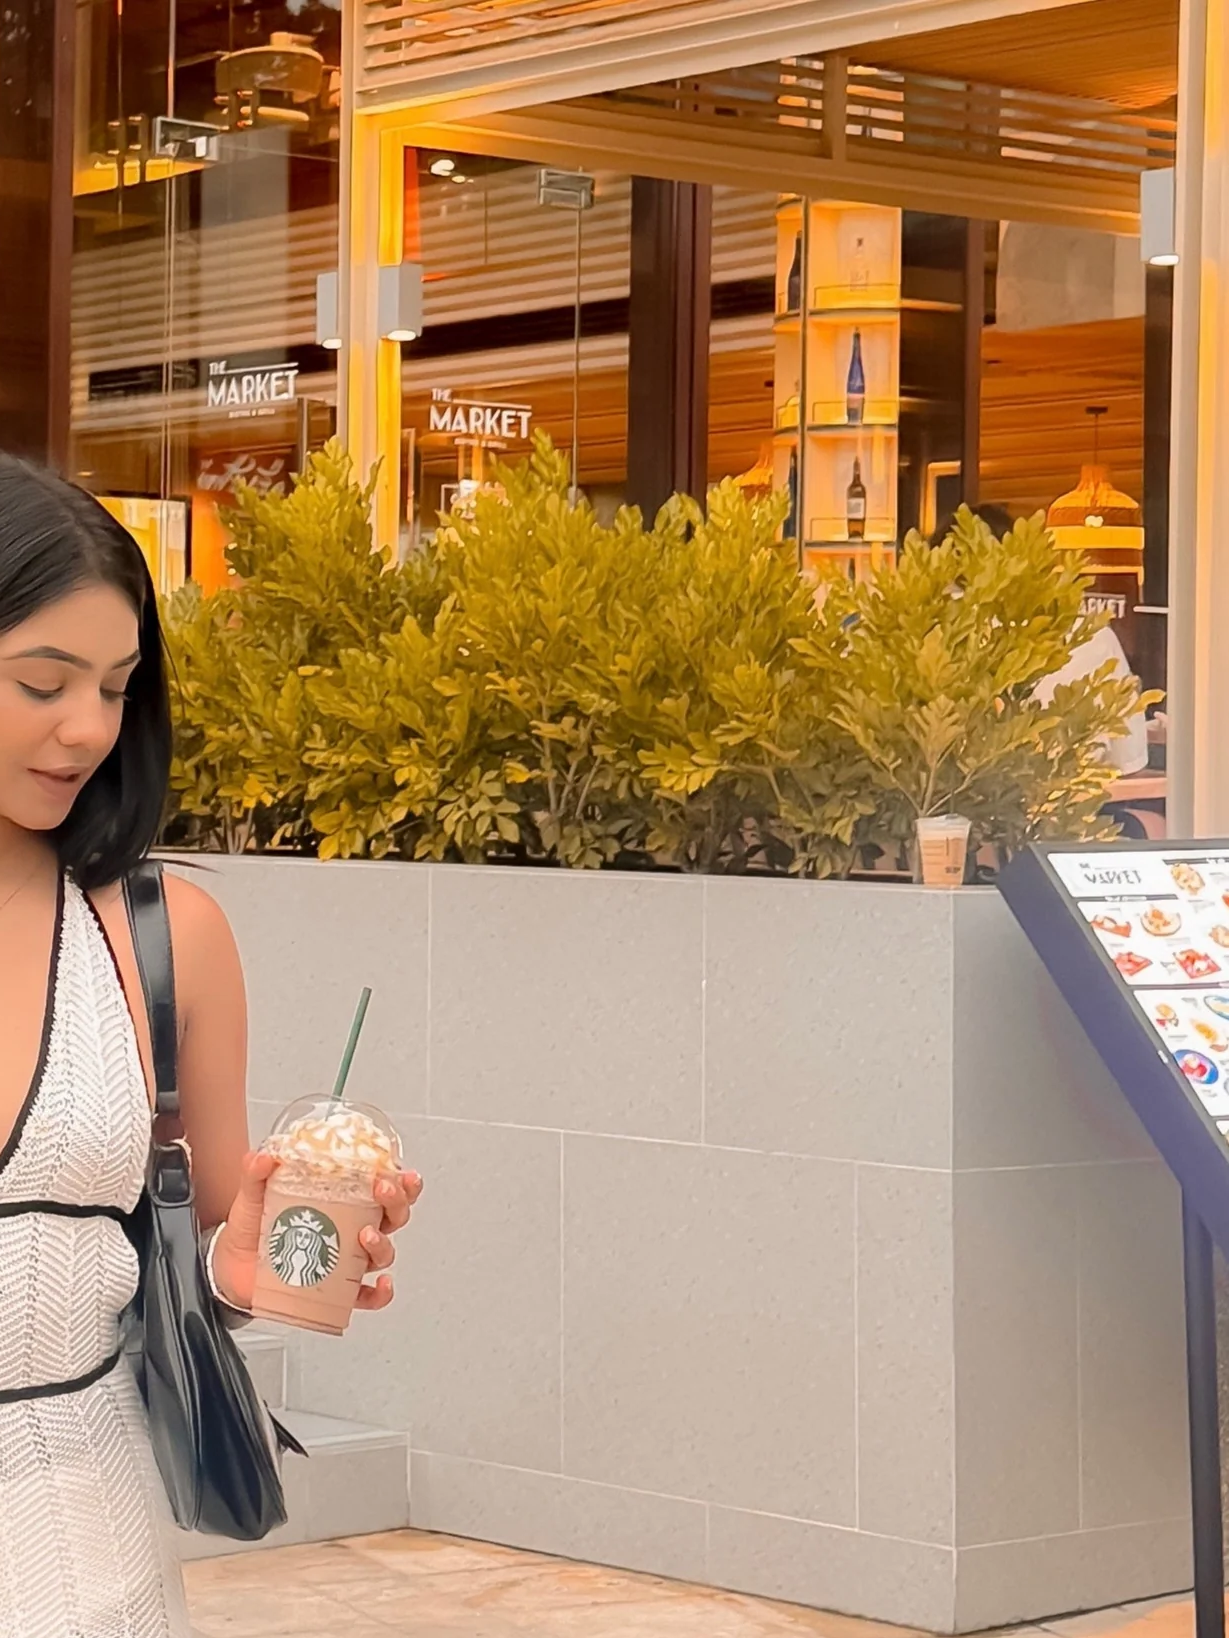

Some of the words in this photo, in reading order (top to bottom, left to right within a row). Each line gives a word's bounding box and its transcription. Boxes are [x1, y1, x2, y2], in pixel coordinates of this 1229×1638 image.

[206, 369, 299, 408] MARKET
[432, 388, 452, 402] THE
[429, 404, 532, 439] MARKET
[1077, 596, 1127, 620] ARKET
